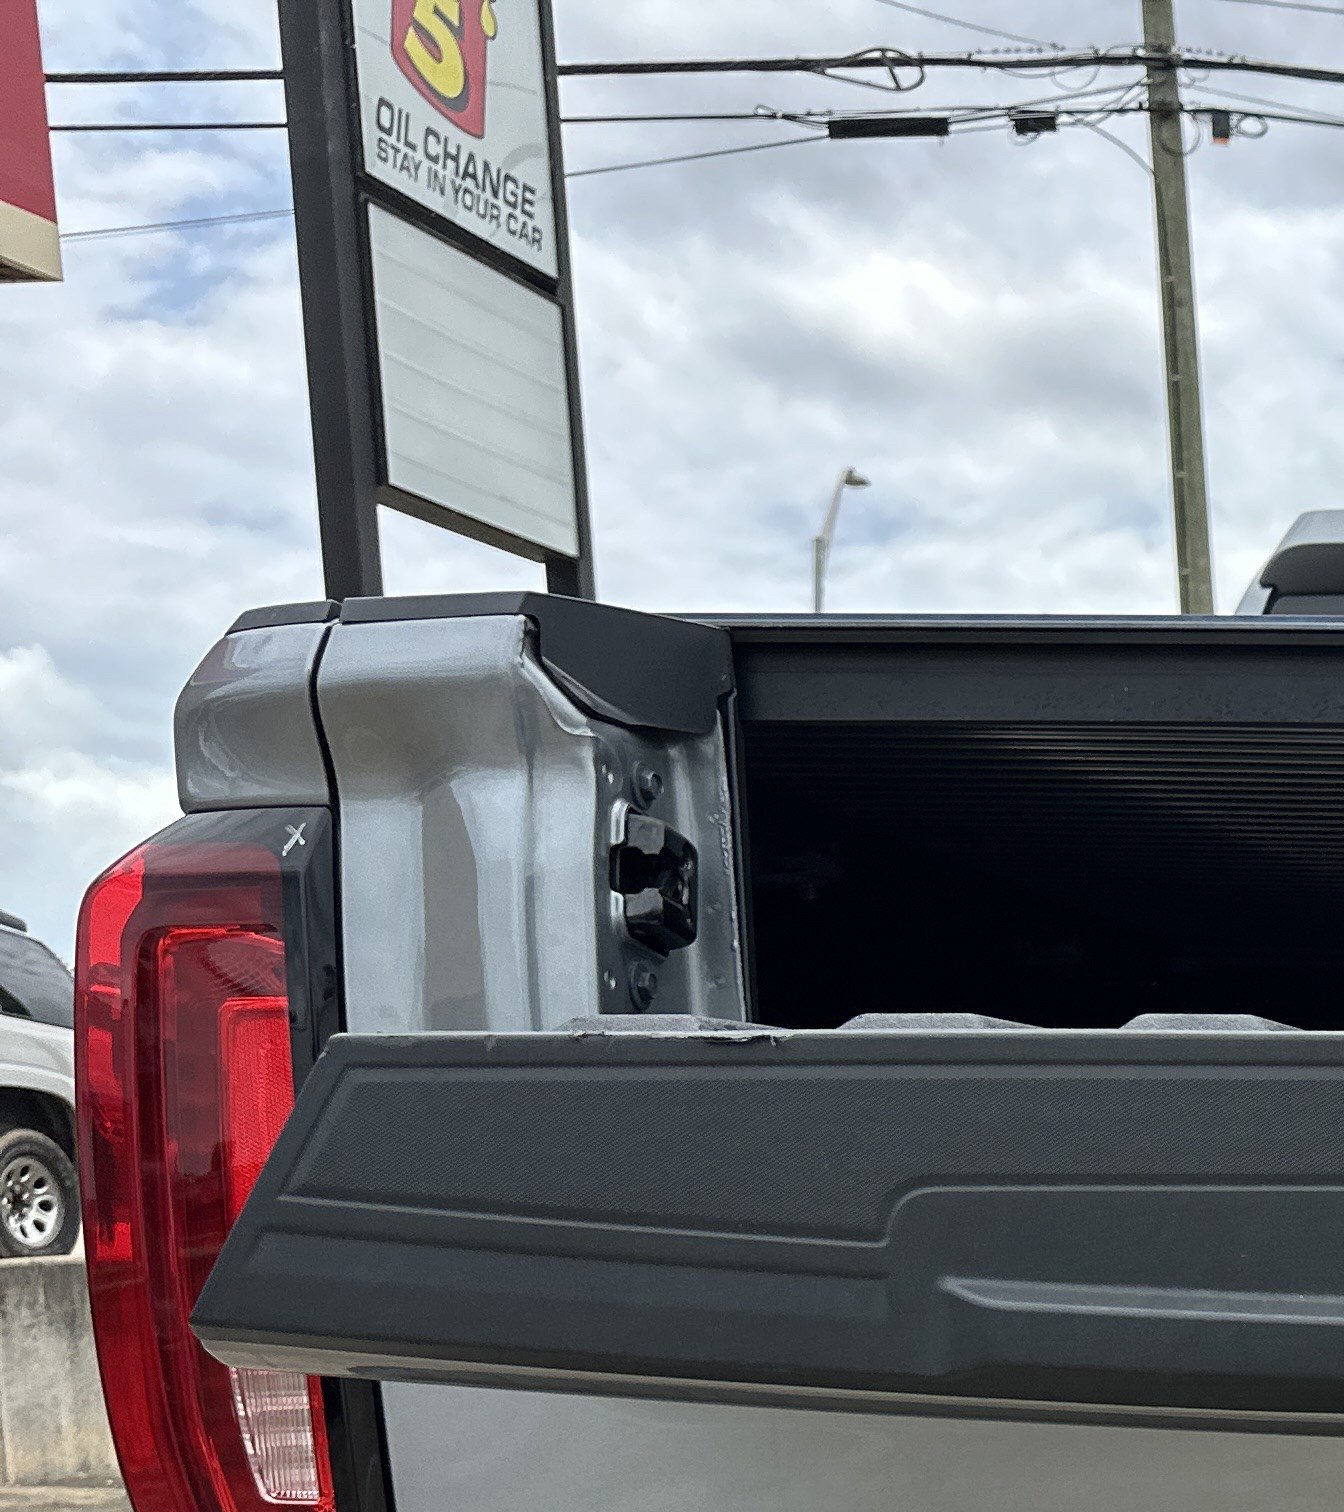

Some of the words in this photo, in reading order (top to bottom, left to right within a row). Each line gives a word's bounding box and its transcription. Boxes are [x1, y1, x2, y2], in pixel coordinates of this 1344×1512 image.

[376, 96, 417, 152] OIL
[423, 126, 537, 220] CHANGE
[376, 137, 422, 183] STAY
[427, 164, 446, 197] IN
[449, 177, 502, 229] YOUR
[506, 211, 543, 251] CAR
